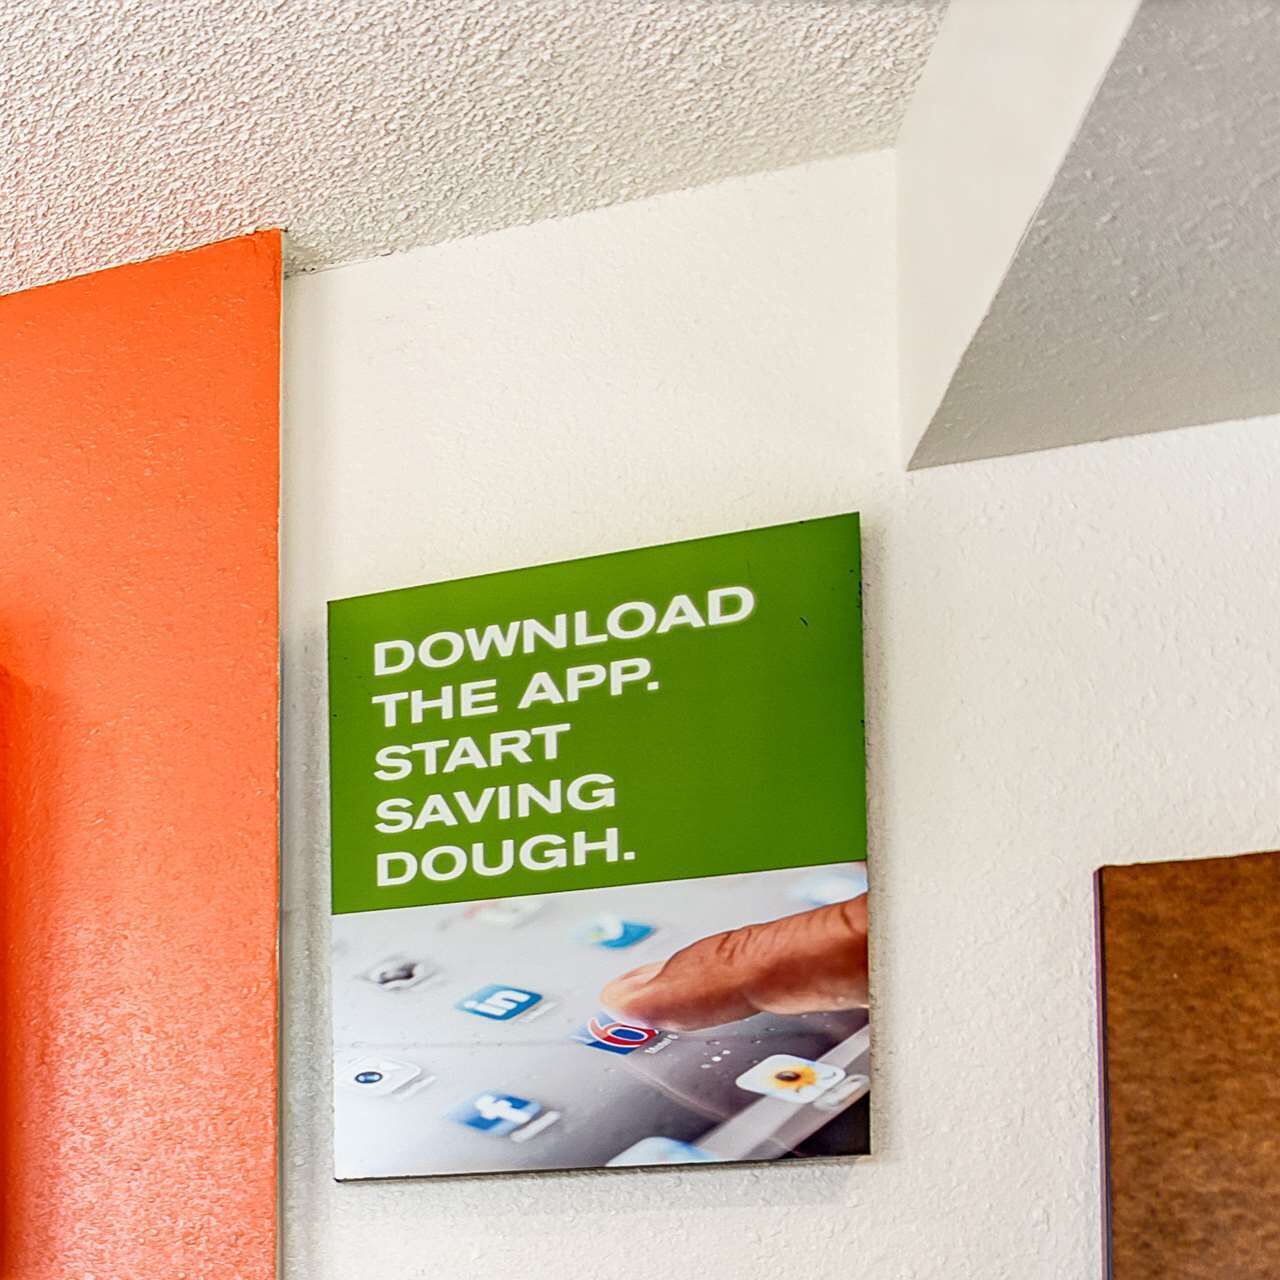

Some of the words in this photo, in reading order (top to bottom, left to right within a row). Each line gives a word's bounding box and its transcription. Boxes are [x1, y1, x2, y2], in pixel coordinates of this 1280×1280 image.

[372, 585, 755, 677] DOWNLOAD
[372, 678, 498, 727] THE
[517, 657, 660, 709] APP.
[373, 722, 571, 781] START
[374, 773, 616, 834] SAVING
[376, 827, 636, 887] DOUGH.
